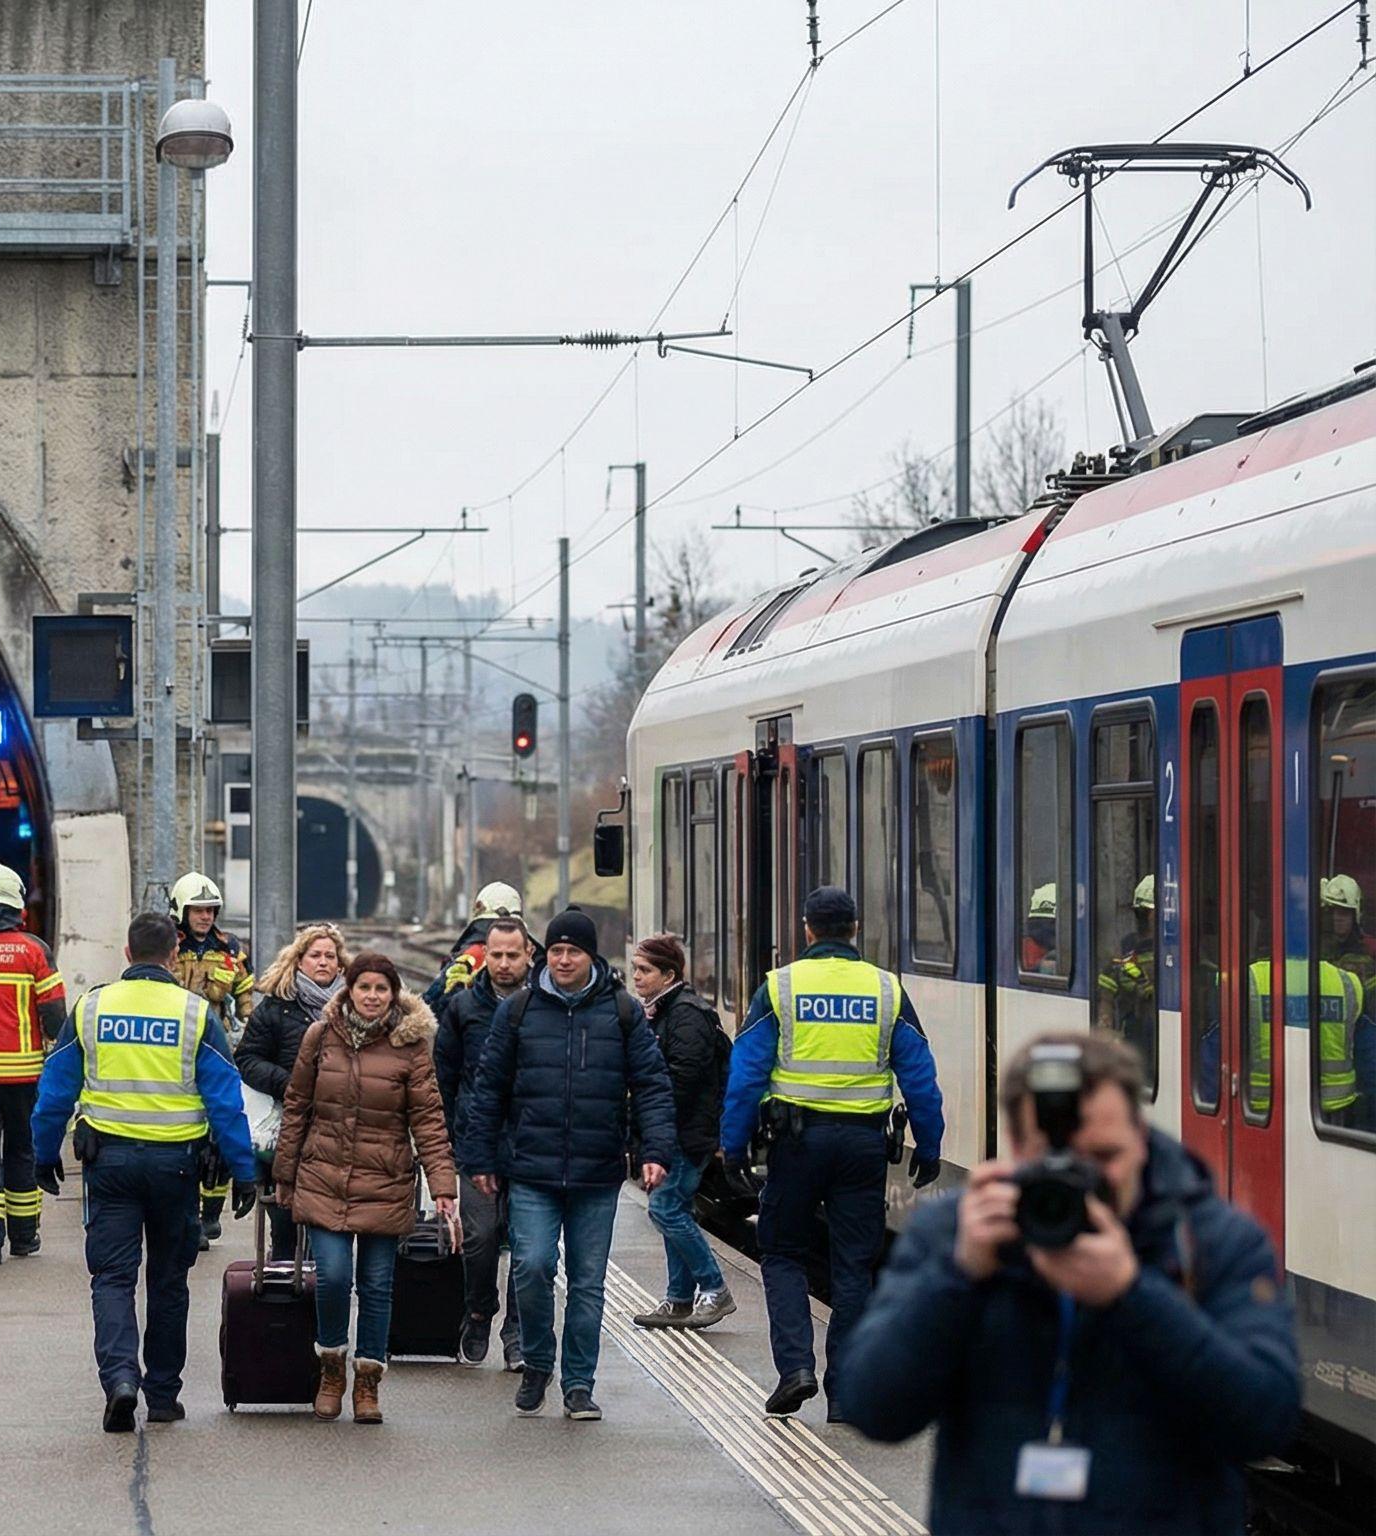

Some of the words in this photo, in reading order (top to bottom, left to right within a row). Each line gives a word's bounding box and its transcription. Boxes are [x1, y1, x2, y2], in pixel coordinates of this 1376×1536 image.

[1165, 760, 1175, 822] 2
[799, 997, 874, 1021] POLICE
[99, 1017, 177, 1044] POLICE
